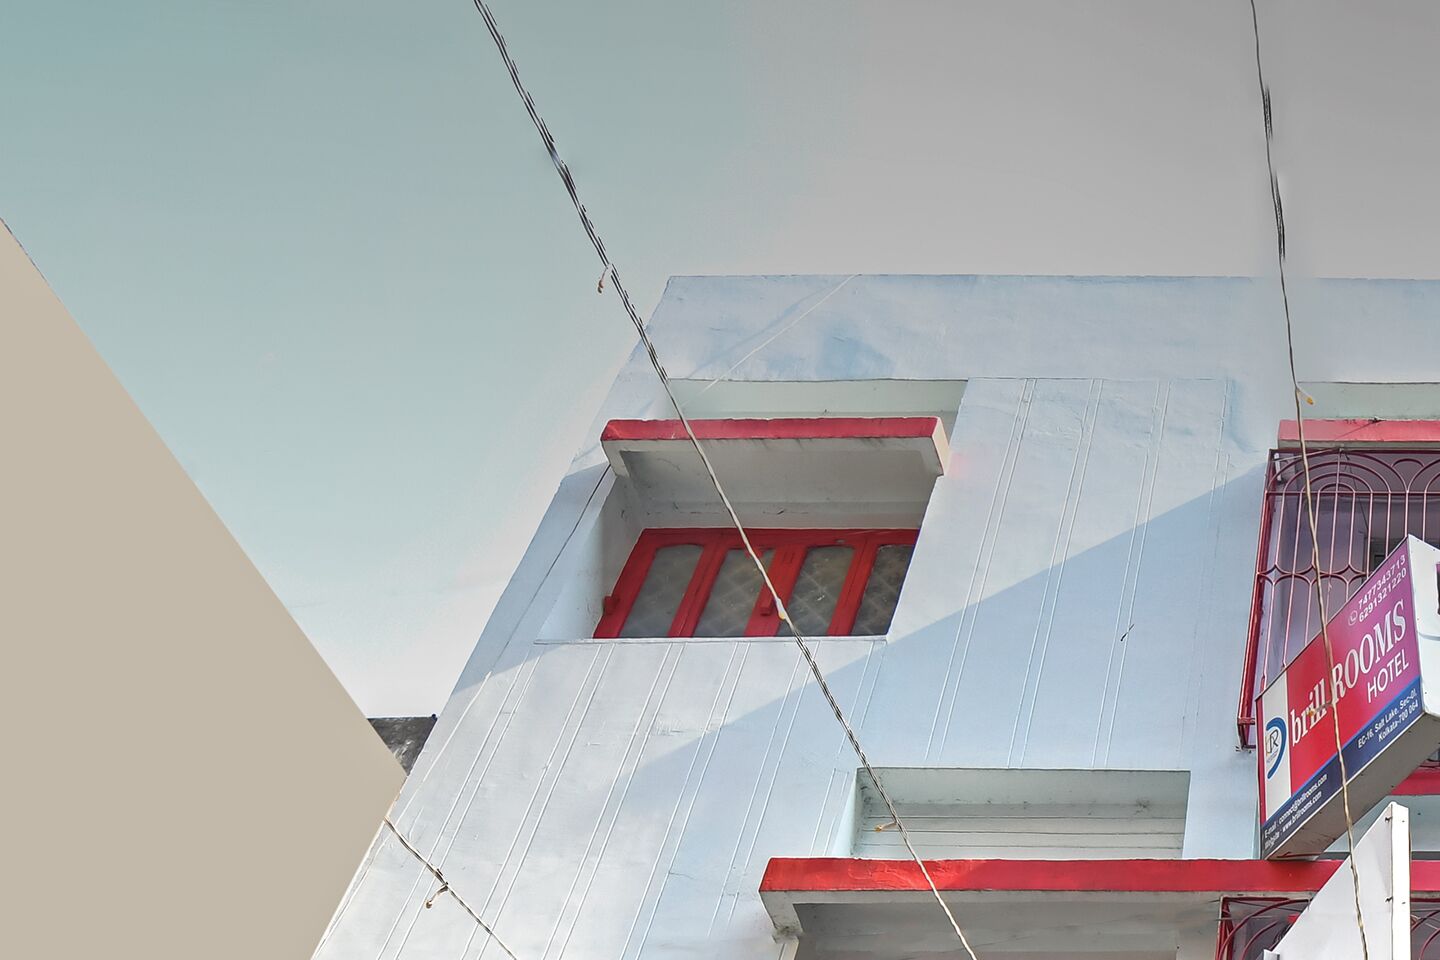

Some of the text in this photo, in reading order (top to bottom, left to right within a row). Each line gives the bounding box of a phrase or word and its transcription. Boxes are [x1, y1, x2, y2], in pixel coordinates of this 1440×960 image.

[1359, 567, 1407, 622] 6291321220
[1290, 599, 1407, 747] brill ROOMS
[1367, 649, 1410, 704] HOTEL
